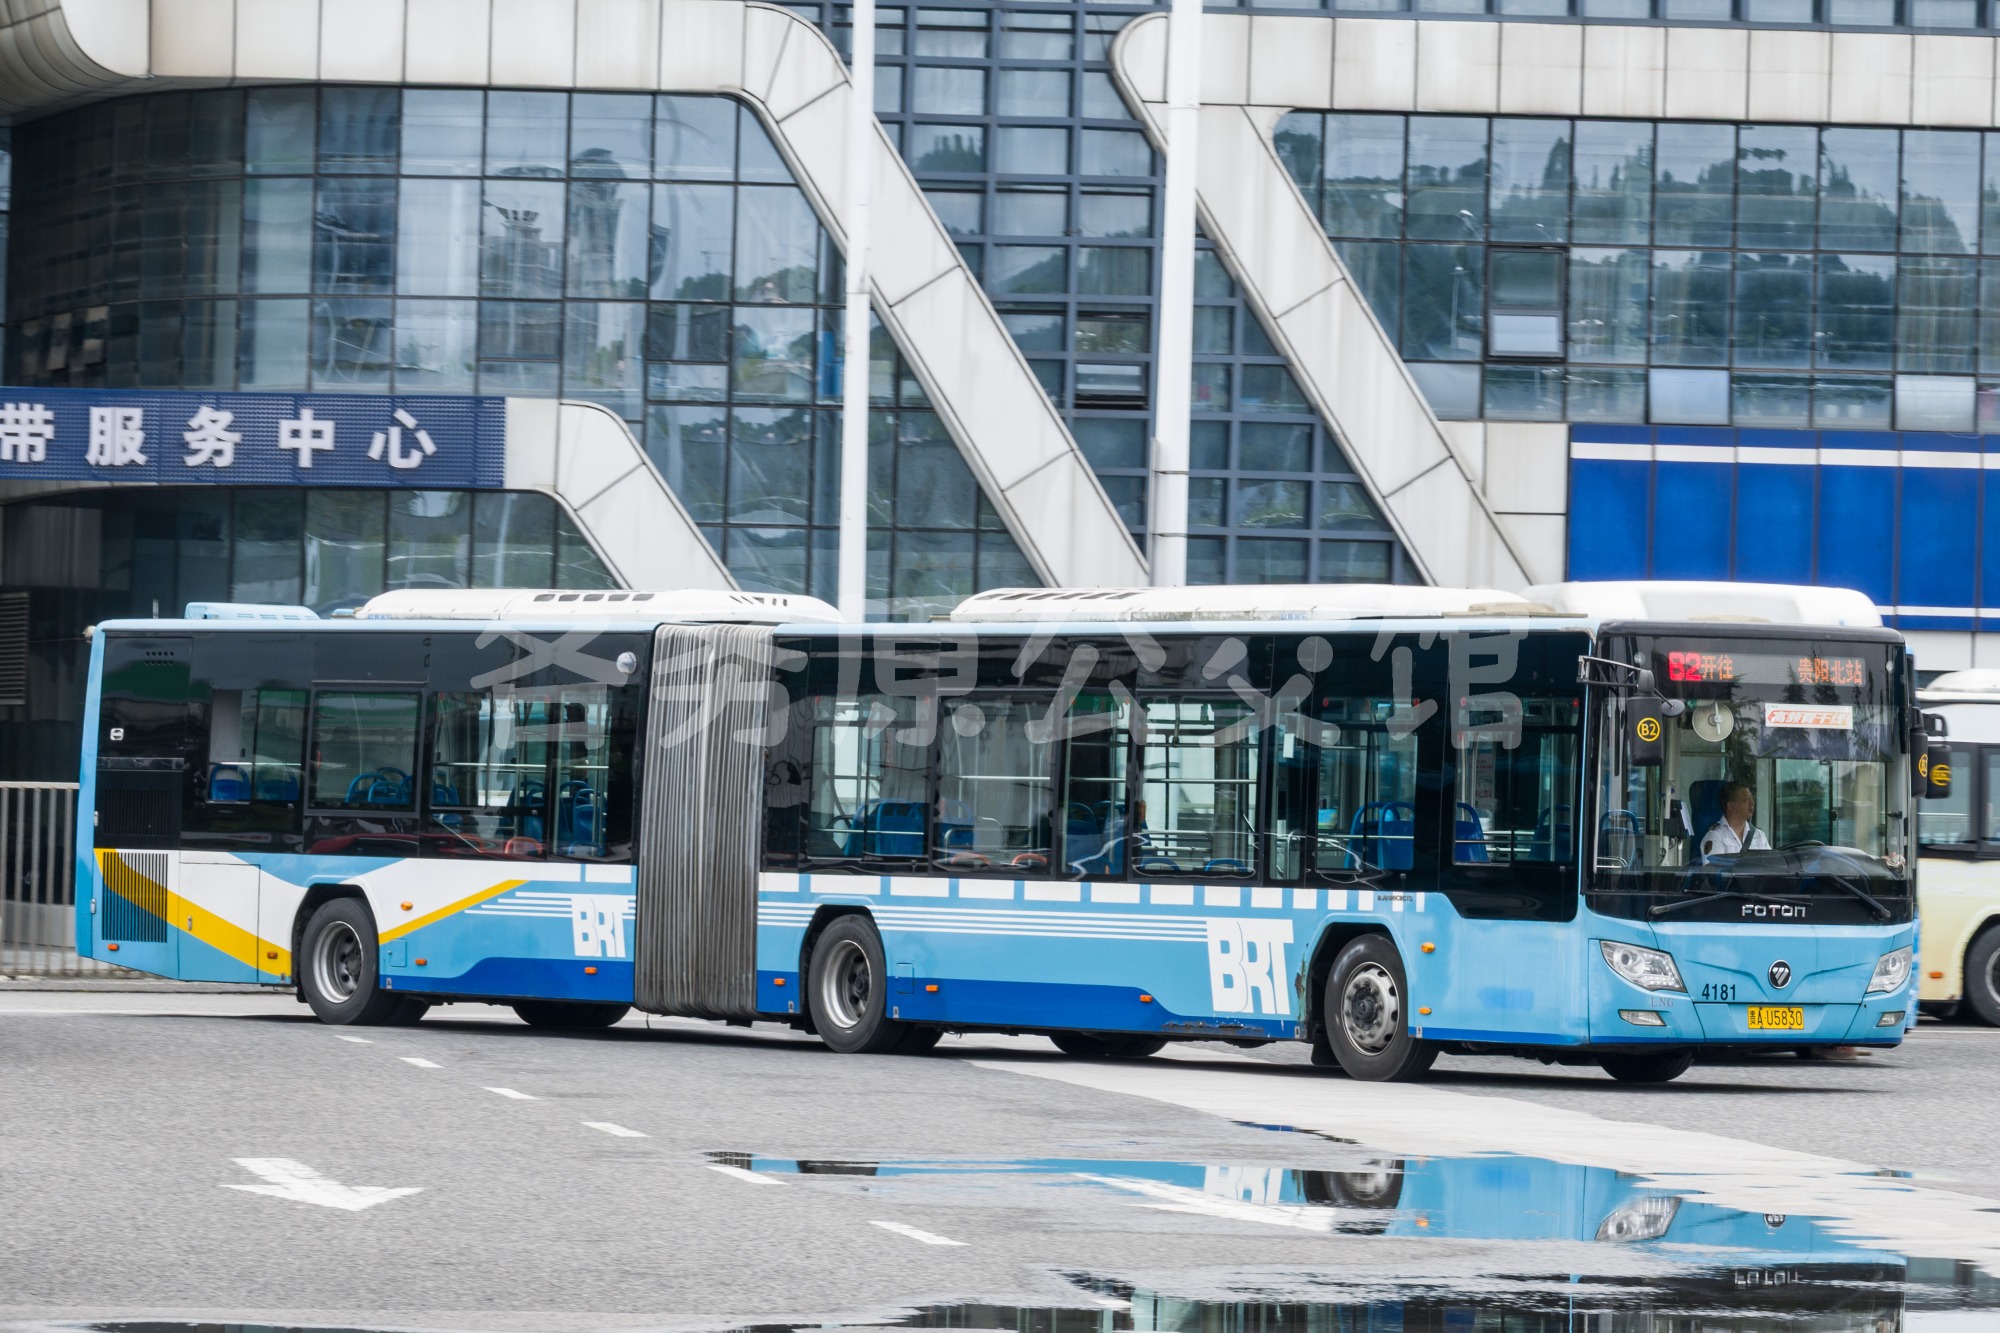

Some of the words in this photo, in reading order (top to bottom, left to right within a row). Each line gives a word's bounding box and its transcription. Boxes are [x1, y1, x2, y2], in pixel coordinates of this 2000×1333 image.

[0, 402, 437, 468] 带服务中心
[1798, 657, 1862, 685] 贵阳北站
[1641, 723, 1657, 736] B2
[1742, 905, 1806, 917] FOTON
[571, 894, 629, 958] BRT
[1206, 918, 1294, 1015] BRT
[1651, 998, 1674, 1008] LNG
[1702, 983, 1736, 1001] 4181
